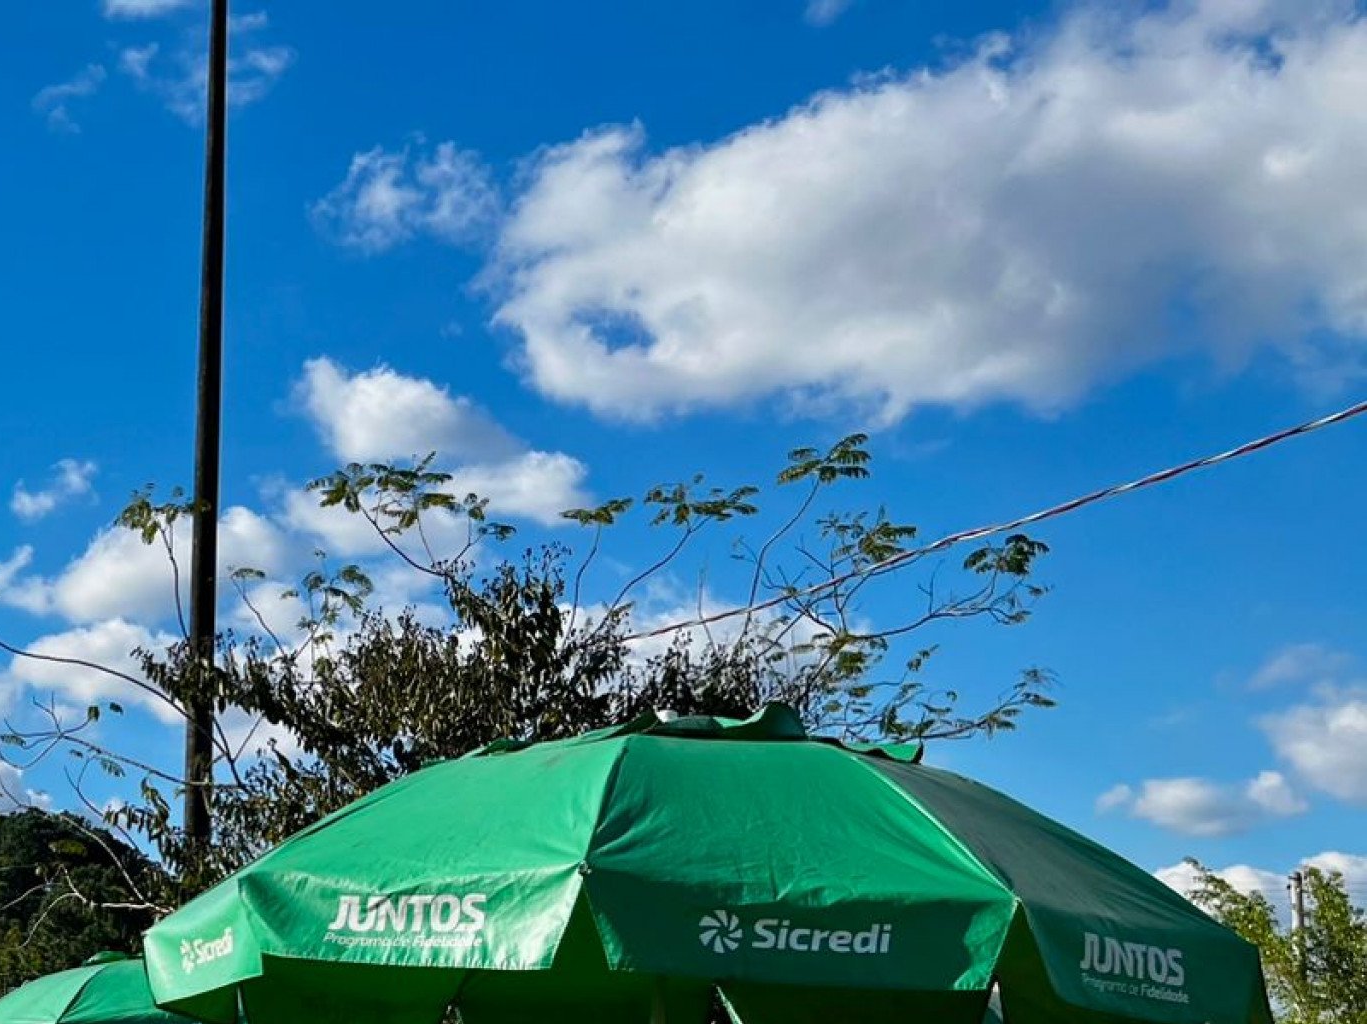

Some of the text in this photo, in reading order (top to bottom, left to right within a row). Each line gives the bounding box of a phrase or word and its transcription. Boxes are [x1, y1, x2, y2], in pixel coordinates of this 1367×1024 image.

[327, 893, 487, 933] JUNTOS
[193, 926, 234, 964] Sicredi
[751, 918, 891, 954] Sicredi
[1080, 931, 1185, 986] JUNTOS
